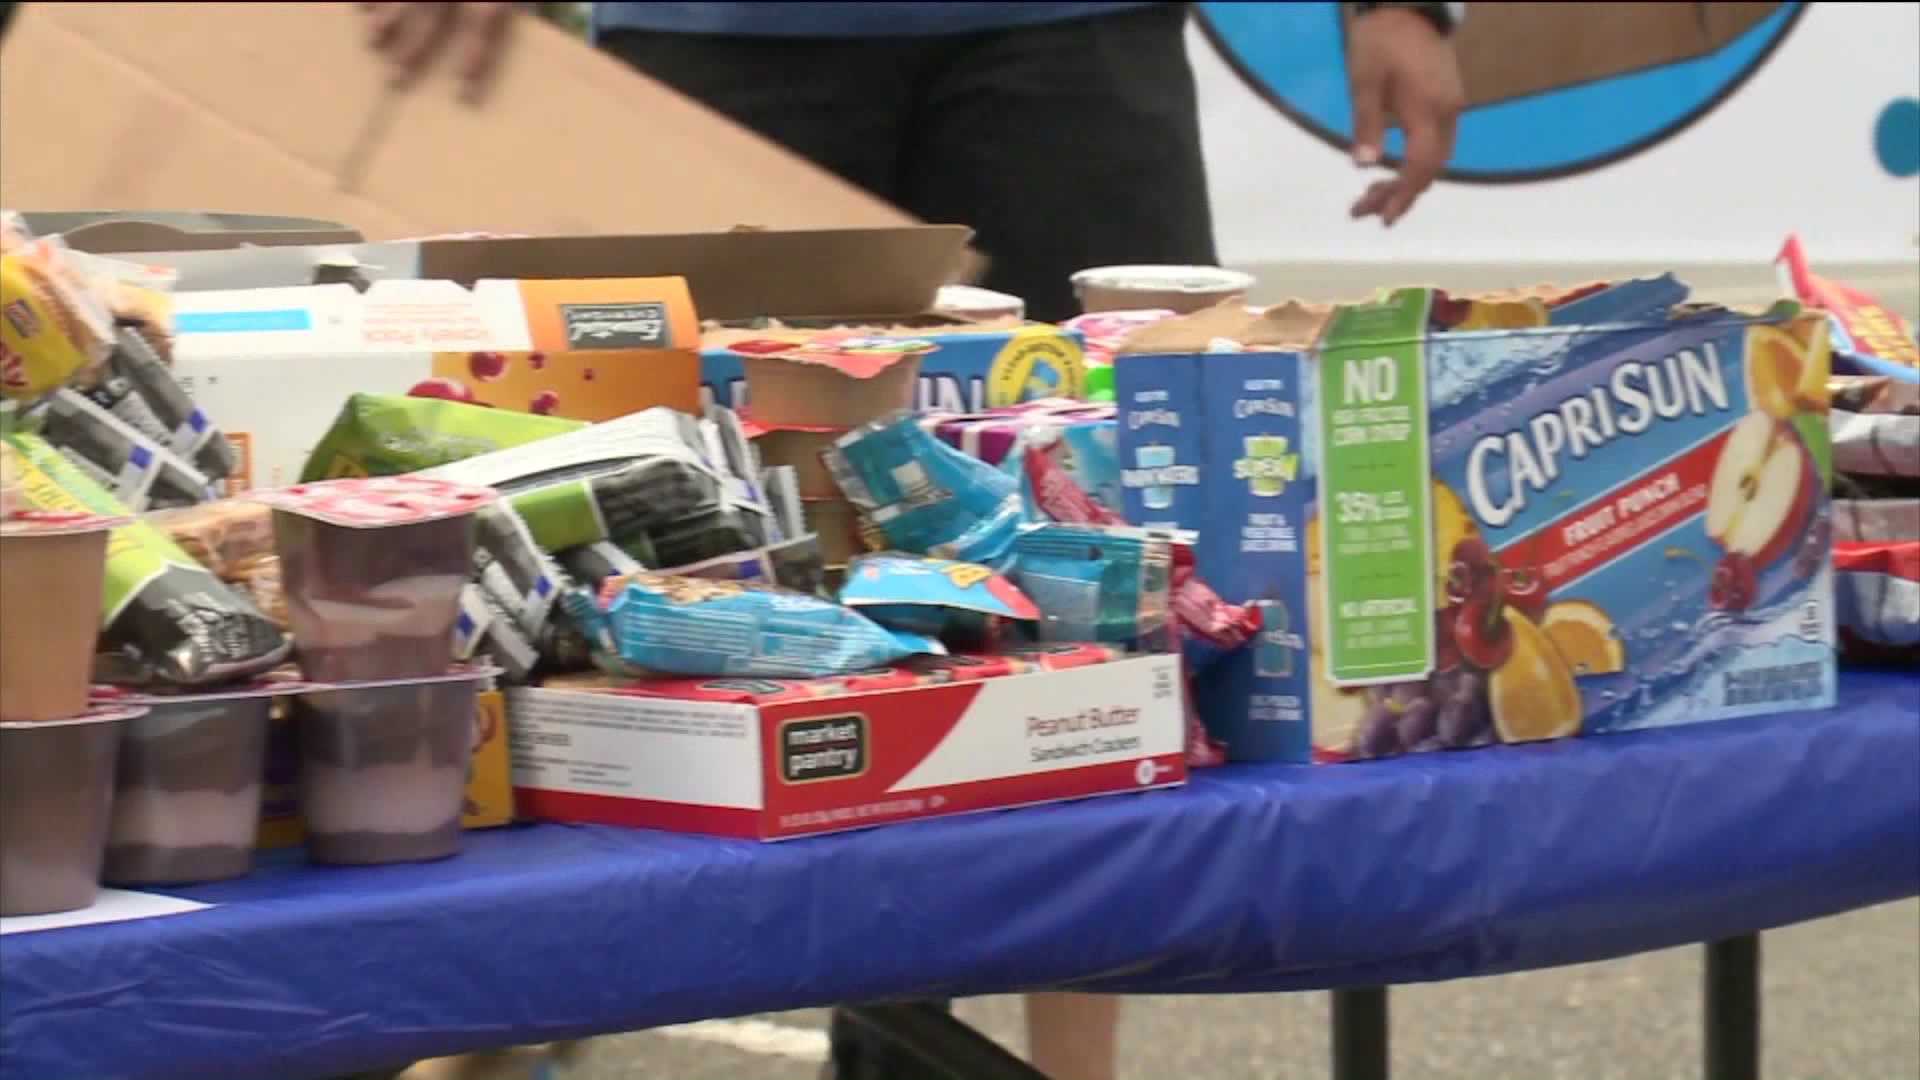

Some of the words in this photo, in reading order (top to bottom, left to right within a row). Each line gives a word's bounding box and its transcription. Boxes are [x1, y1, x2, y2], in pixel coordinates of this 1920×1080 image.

[1343, 356, 1398, 405] NO
[1562, 505, 1616, 547] FRUIT
[1616, 471, 1681, 519] PUNCH
[787, 722, 858, 746] market
[1026, 711, 1086, 738] Peanut
[1088, 705, 1140, 731] Butter
[789, 748, 858, 778] pantry
